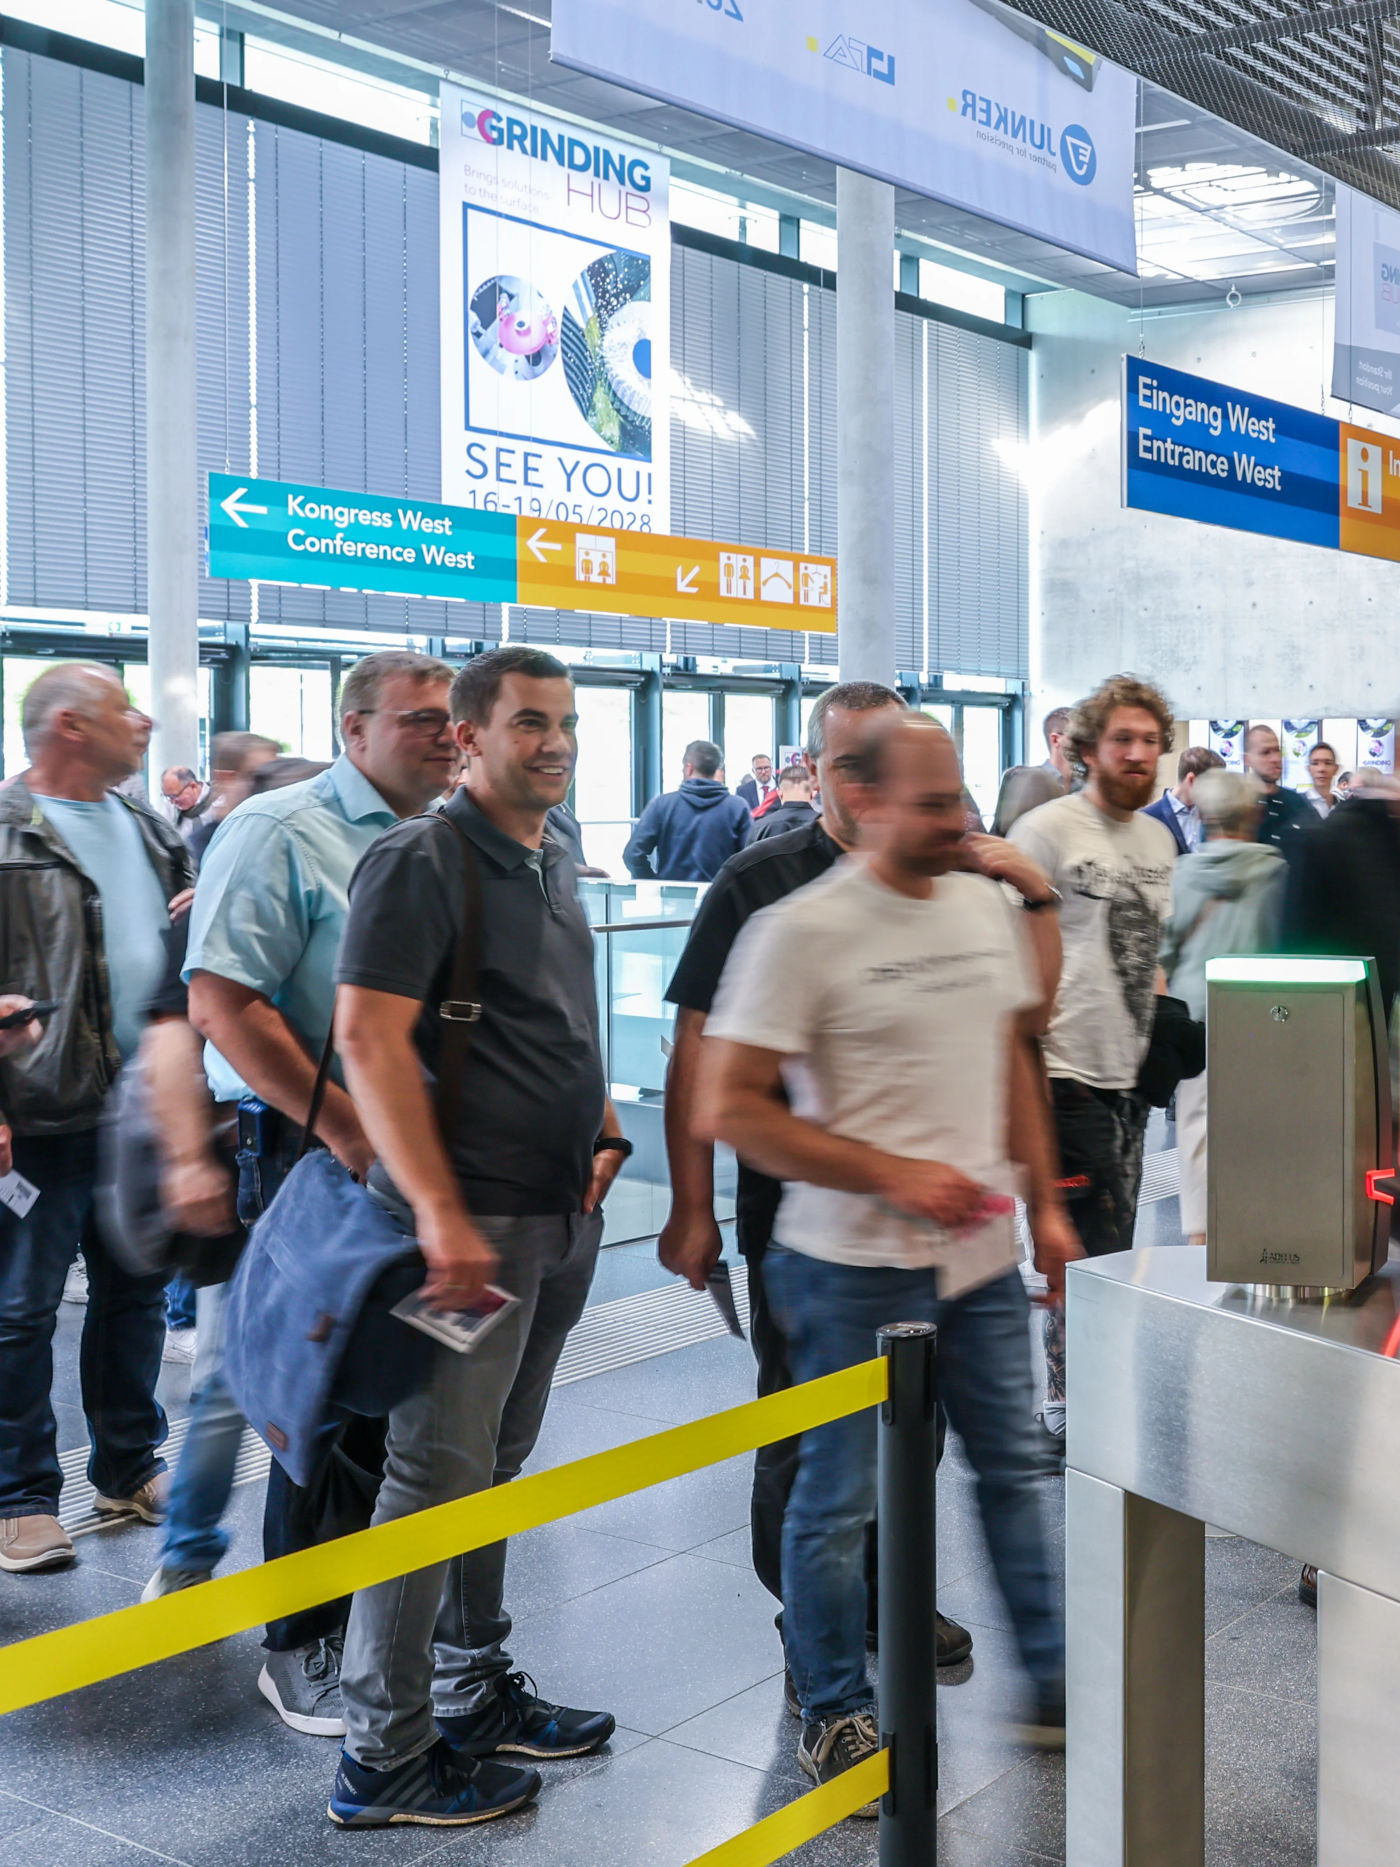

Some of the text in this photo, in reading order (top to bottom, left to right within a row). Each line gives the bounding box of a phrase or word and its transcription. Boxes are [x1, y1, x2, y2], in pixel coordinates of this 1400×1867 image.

[463, 163, 499, 187] Brings
[477, 109, 652, 193] GRINDING
[463, 182, 477, 196] to
[478, 185, 498, 201] the
[567, 172, 652, 229] HUB
[1138, 375, 1276, 443] Eingang West
[465, 442, 652, 505] SEE YOU!
[1138, 427, 1282, 491] Entrance West
[287, 494, 452, 536] Kongress West
[286, 528, 475, 570] Conference West
